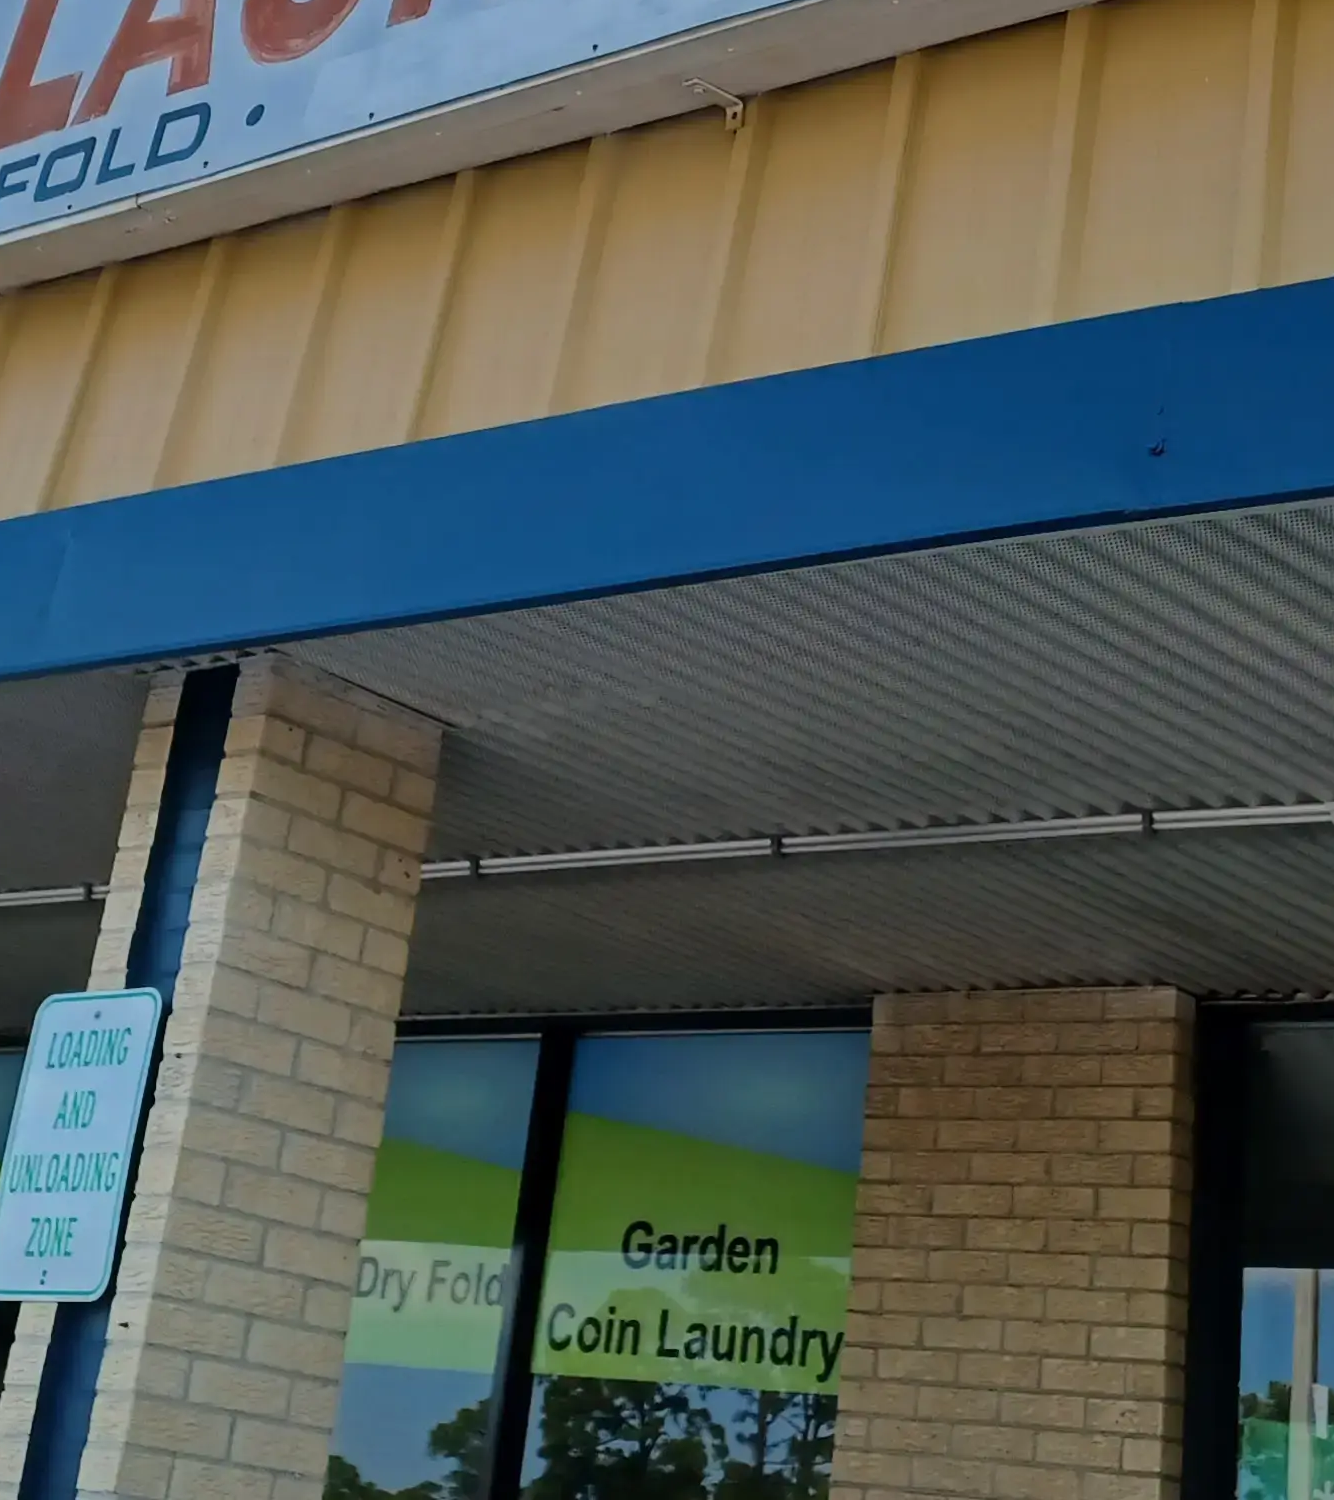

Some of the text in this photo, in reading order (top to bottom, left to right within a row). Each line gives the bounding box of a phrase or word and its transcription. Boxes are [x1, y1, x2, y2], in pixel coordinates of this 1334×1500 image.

[45, 1026, 133, 1070] LOADING
[53, 1090, 97, 1130] AND
[8, 1152, 119, 1193] UNLOADING
[24, 1216, 79, 1258] ZONE
[621, 1220, 780, 1275] Garden
[355, 1256, 512, 1313] Dry Fold
[547, 1302, 845, 1383] Coin Laundry
